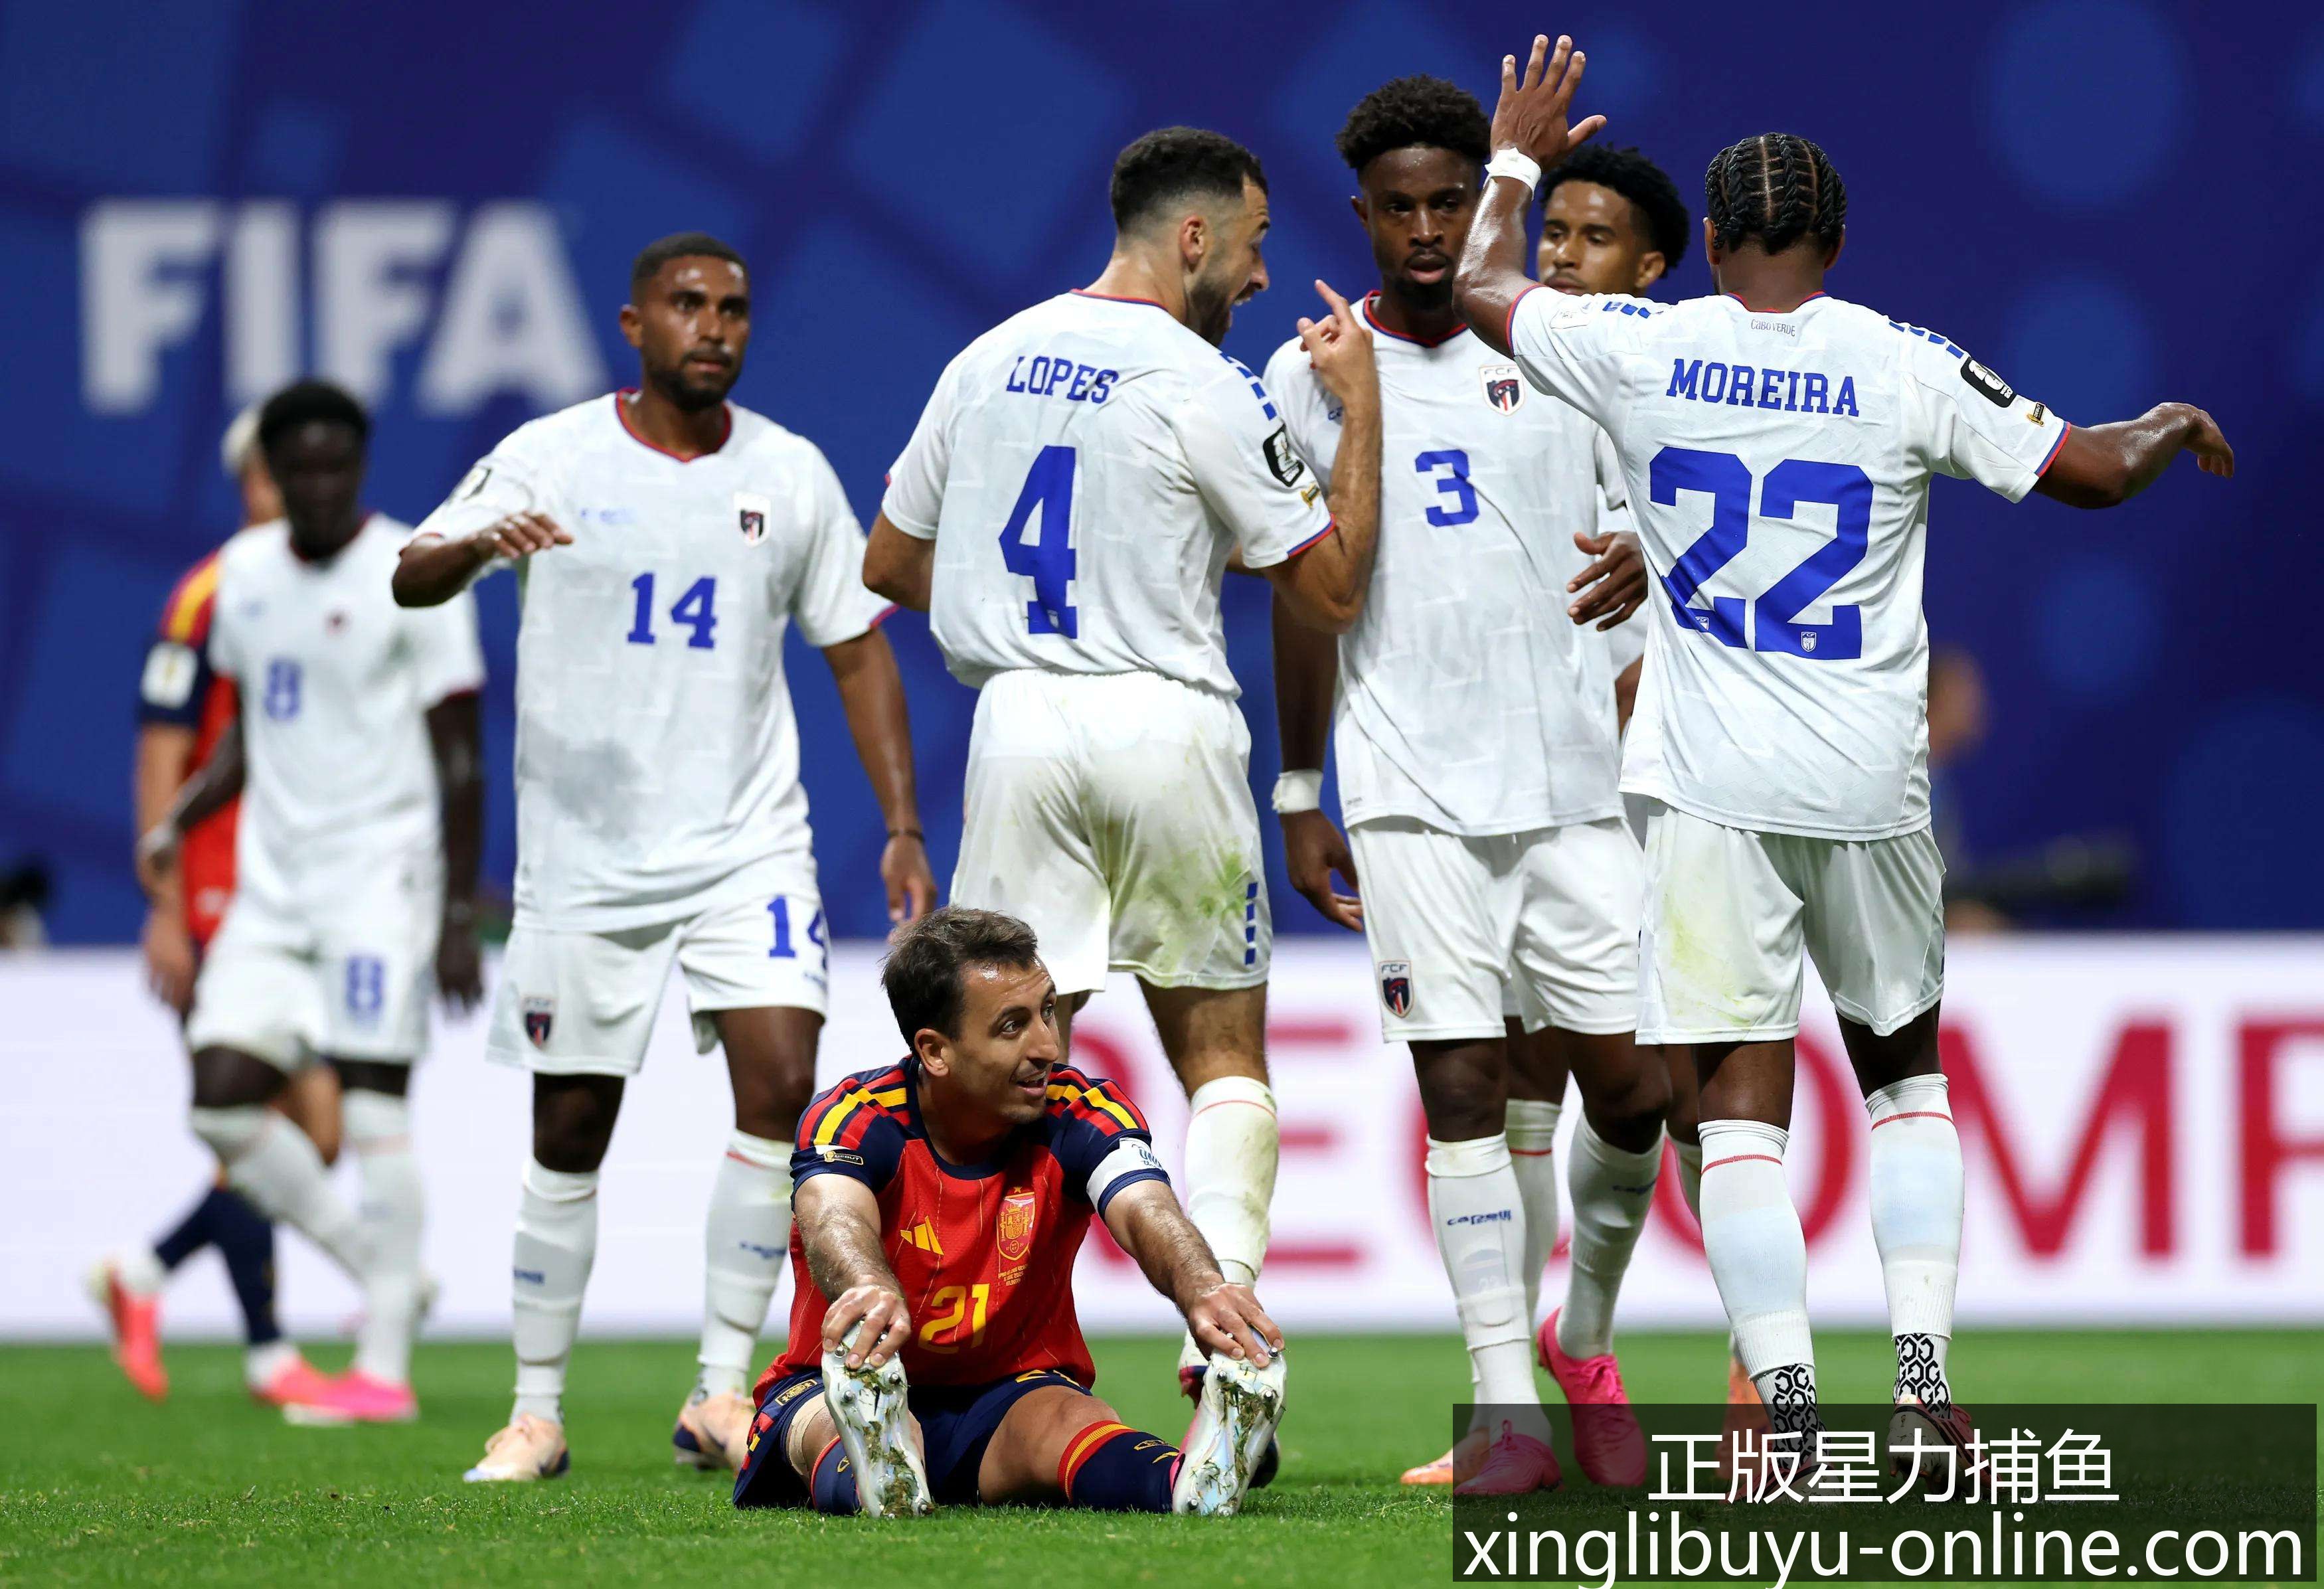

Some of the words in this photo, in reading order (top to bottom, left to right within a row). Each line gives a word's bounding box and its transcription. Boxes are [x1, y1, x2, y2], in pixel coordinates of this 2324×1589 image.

[82, 201, 611, 414] FIFA
[1007, 355, 1120, 404] LOPES
[1667, 358, 1860, 417] MOREIRA
[1415, 449, 1479, 527] 3
[999, 445, 1078, 639] 4
[1649, 446, 1874, 660] 22
[627, 572, 718, 649] 14
[266, 658, 301, 722] 8
[346, 955, 384, 1020] 8
[1381, 963, 1408, 974] FCF
[918, 1283, 990, 1354] 21
